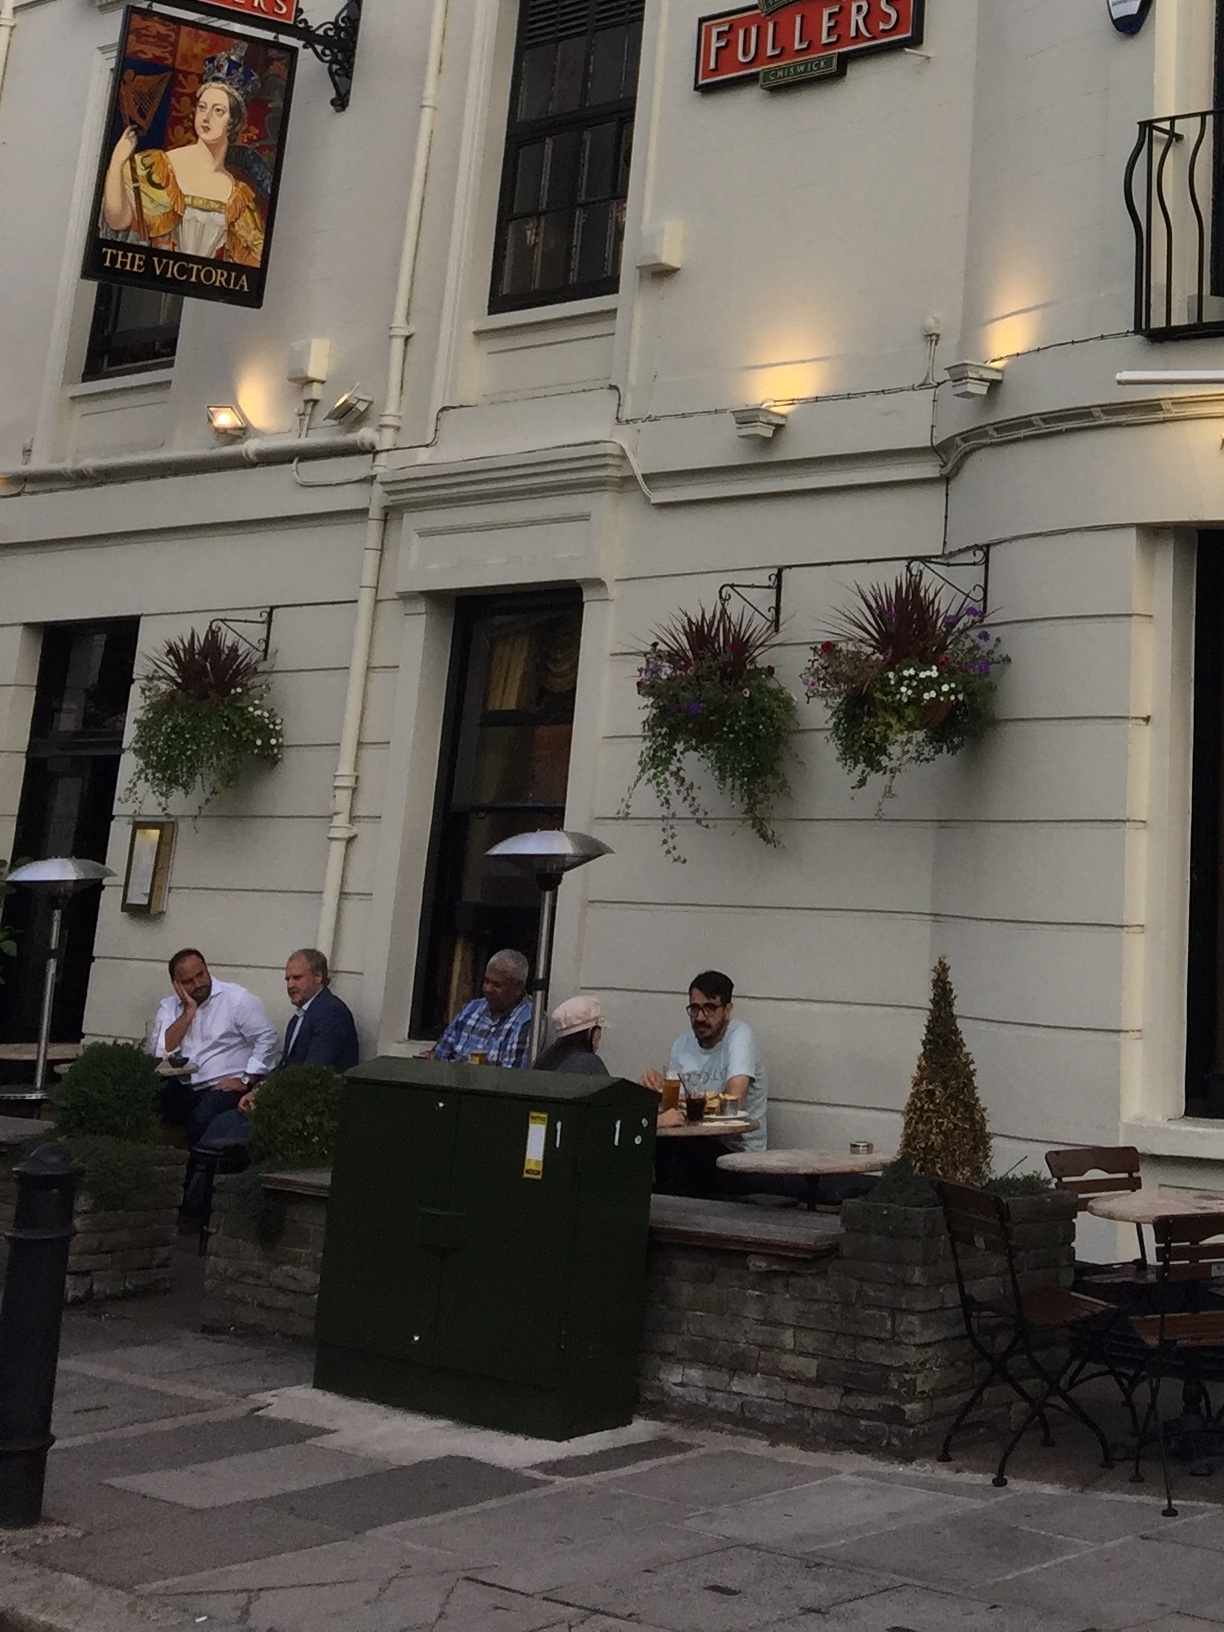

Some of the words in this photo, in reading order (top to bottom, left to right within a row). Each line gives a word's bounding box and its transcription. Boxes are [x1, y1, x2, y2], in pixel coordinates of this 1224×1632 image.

[769, 59, 827, 80] CHISWICK
[102, 247, 146, 273] THE
[152, 256, 250, 292] VICTORIA
